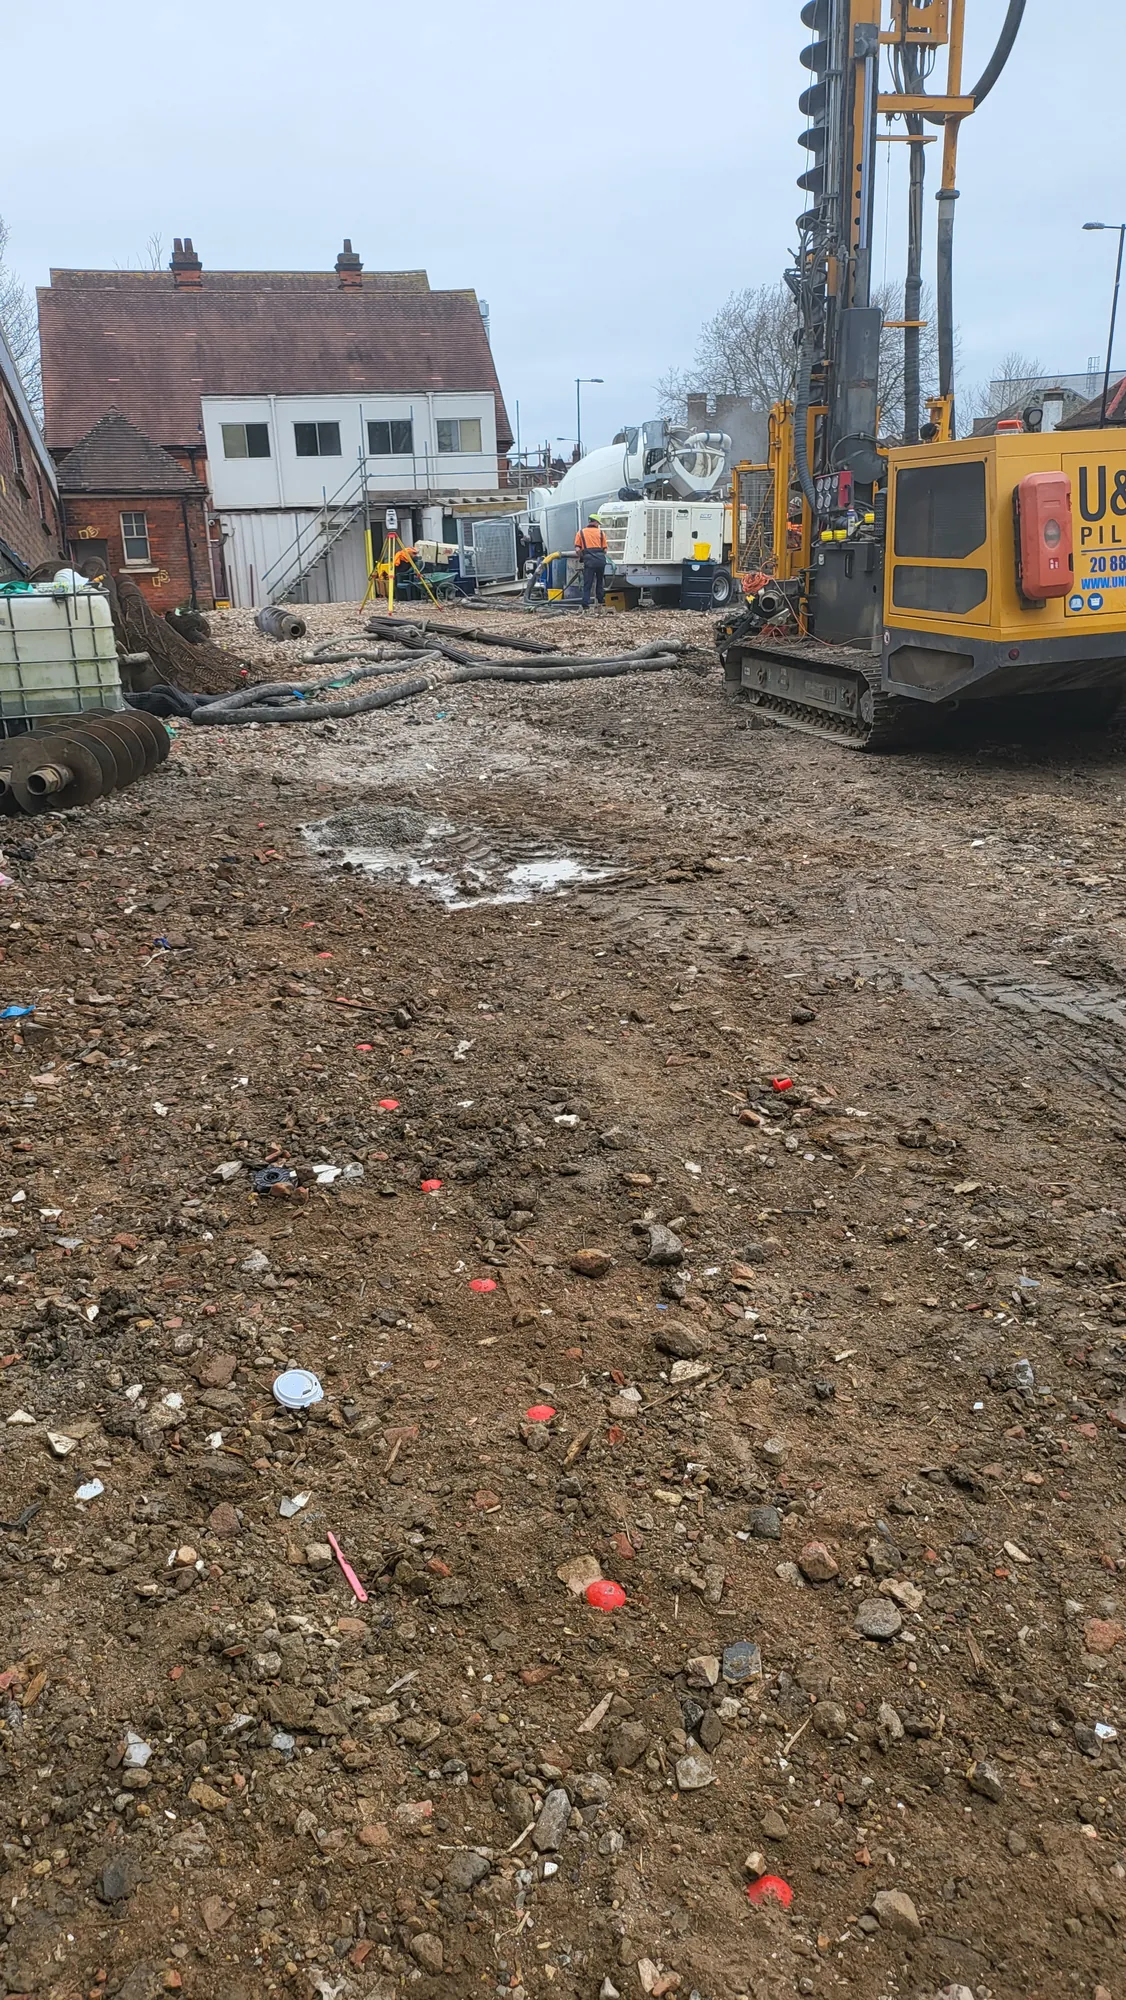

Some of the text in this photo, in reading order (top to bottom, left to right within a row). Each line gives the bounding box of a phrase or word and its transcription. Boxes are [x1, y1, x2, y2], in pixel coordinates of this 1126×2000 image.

[1079, 465, 1126, 522] U&
[1081, 525, 1122, 545] PIL
[1090, 555, 1126, 573] 20 88
